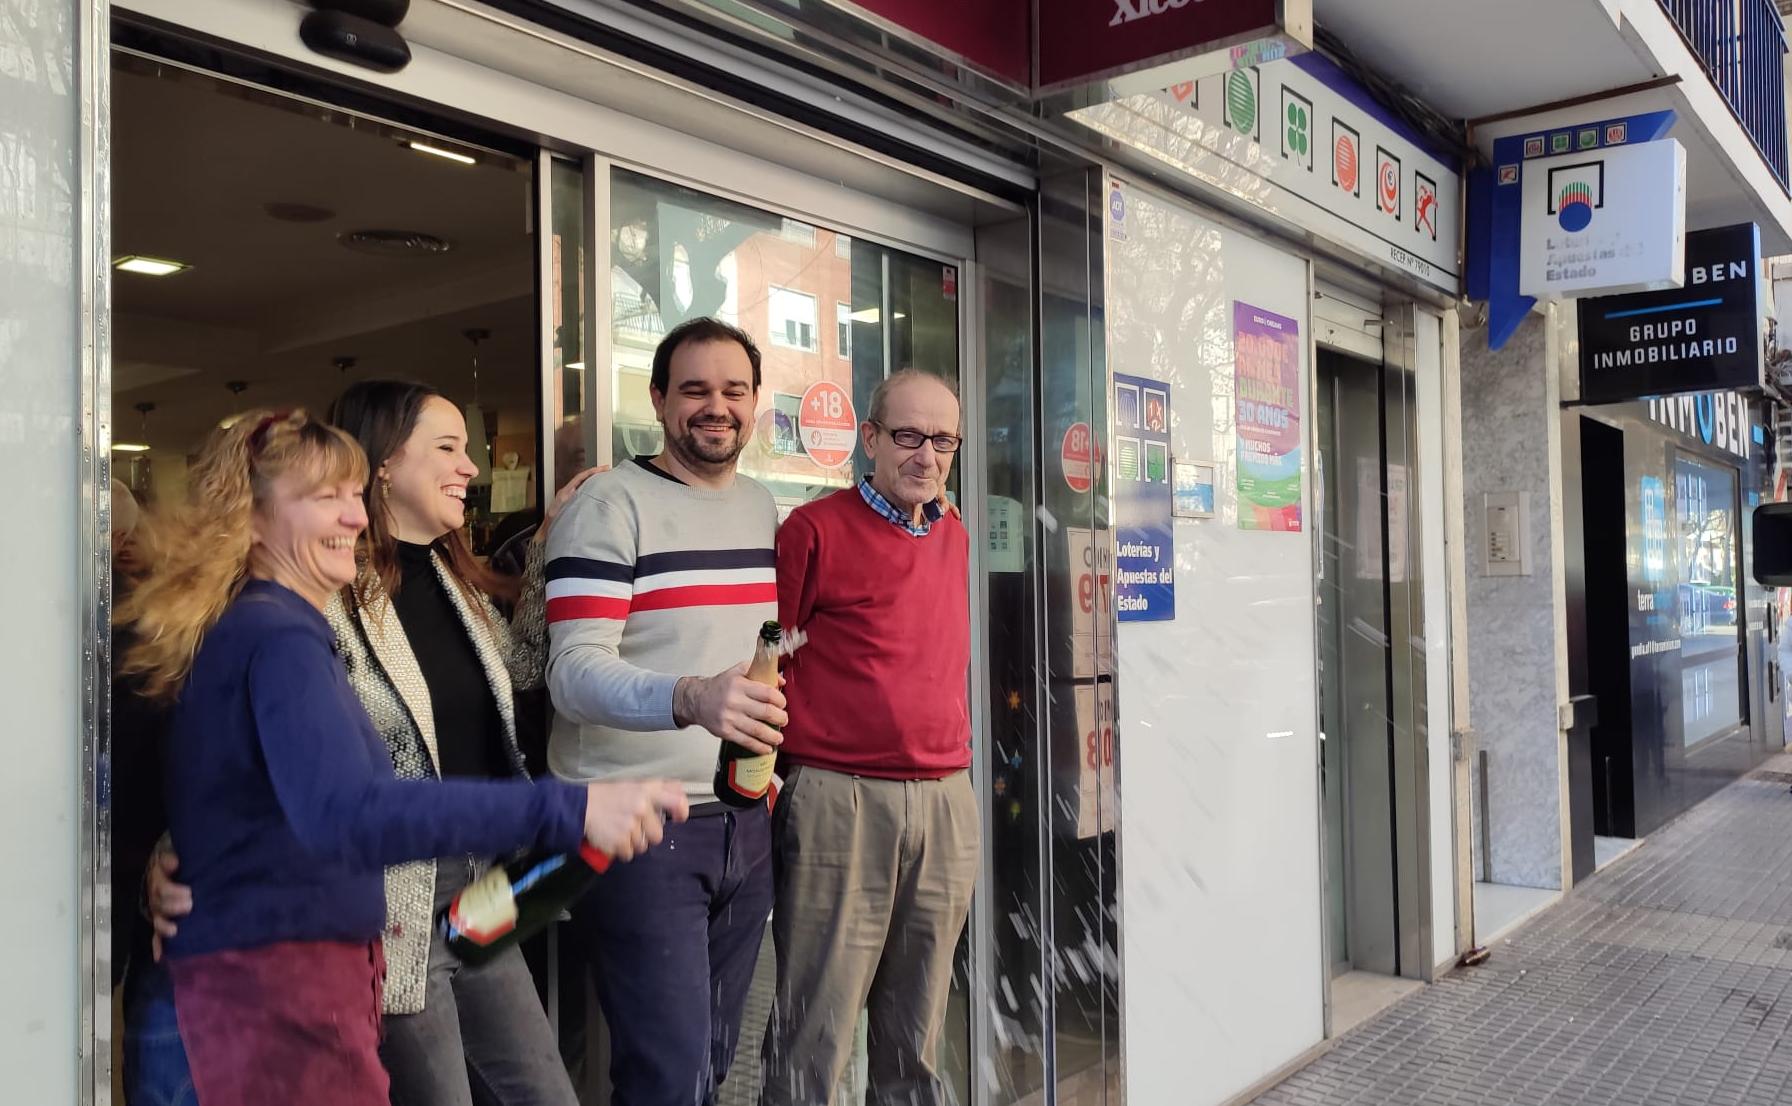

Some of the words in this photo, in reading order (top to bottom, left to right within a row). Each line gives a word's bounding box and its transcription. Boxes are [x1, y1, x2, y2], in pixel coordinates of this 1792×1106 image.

[1546, 264, 1597, 282] Estado
[1691, 260, 1747, 285] BEN
[1630, 318, 1697, 342] GRUPO
[1594, 337, 1738, 370] INMOBILIARIO
[811, 390, 843, 419] +18
[1245, 440, 1271, 453] MUCHOS
[1116, 541, 1152, 557] Loterías
[1154, 545, 1160, 562] y
[1116, 567, 1157, 588] Apuestas
[1159, 567, 1173, 585] del
[1117, 593, 1149, 611] Estado
